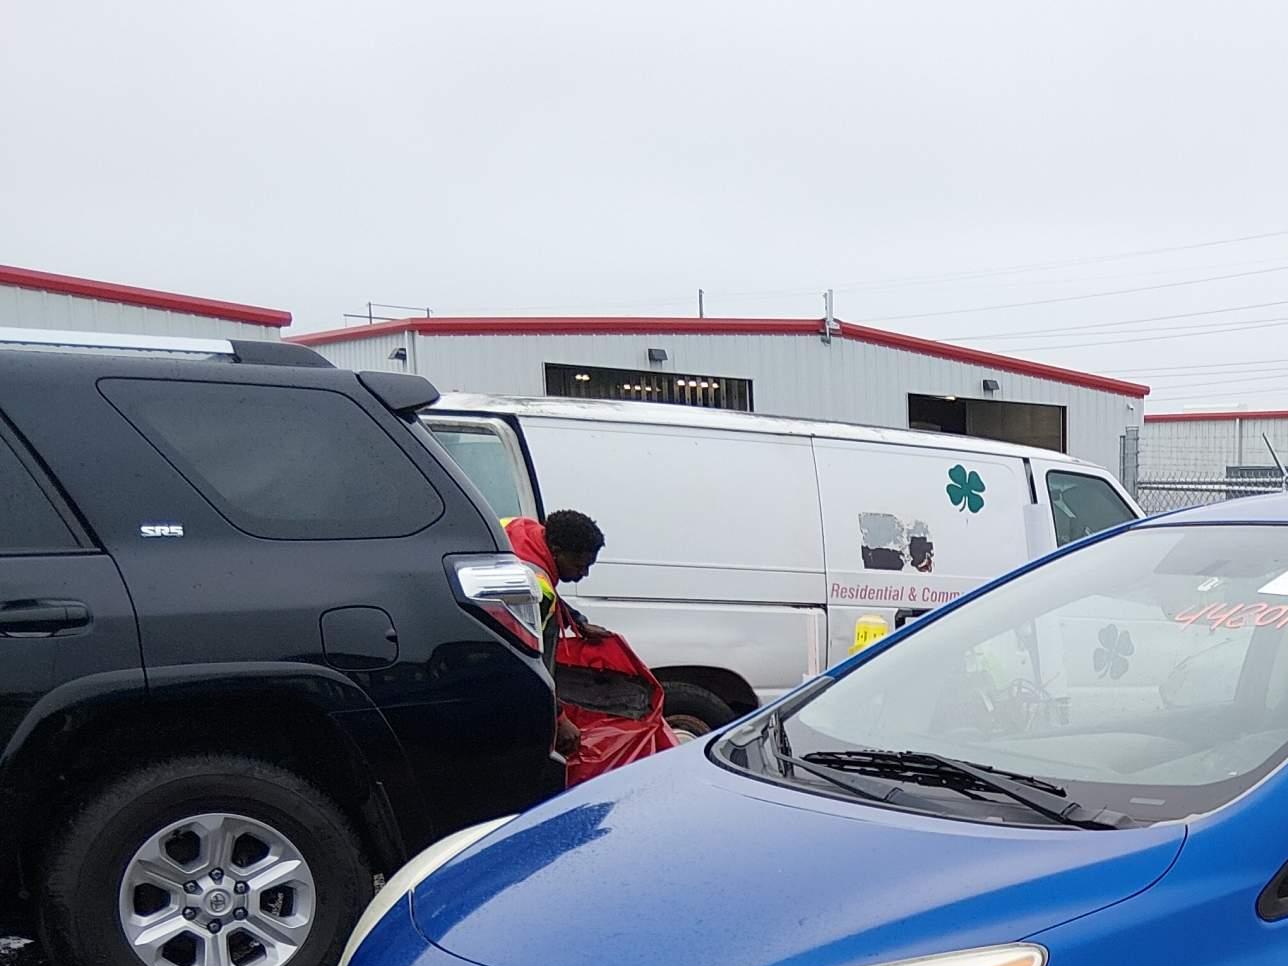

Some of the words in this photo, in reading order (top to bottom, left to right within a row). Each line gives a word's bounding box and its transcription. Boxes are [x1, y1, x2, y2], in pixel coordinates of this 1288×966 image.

[831, 583, 904, 601] Residential
[908, 587, 918, 602] &
[922, 587, 965, 603] Comm
